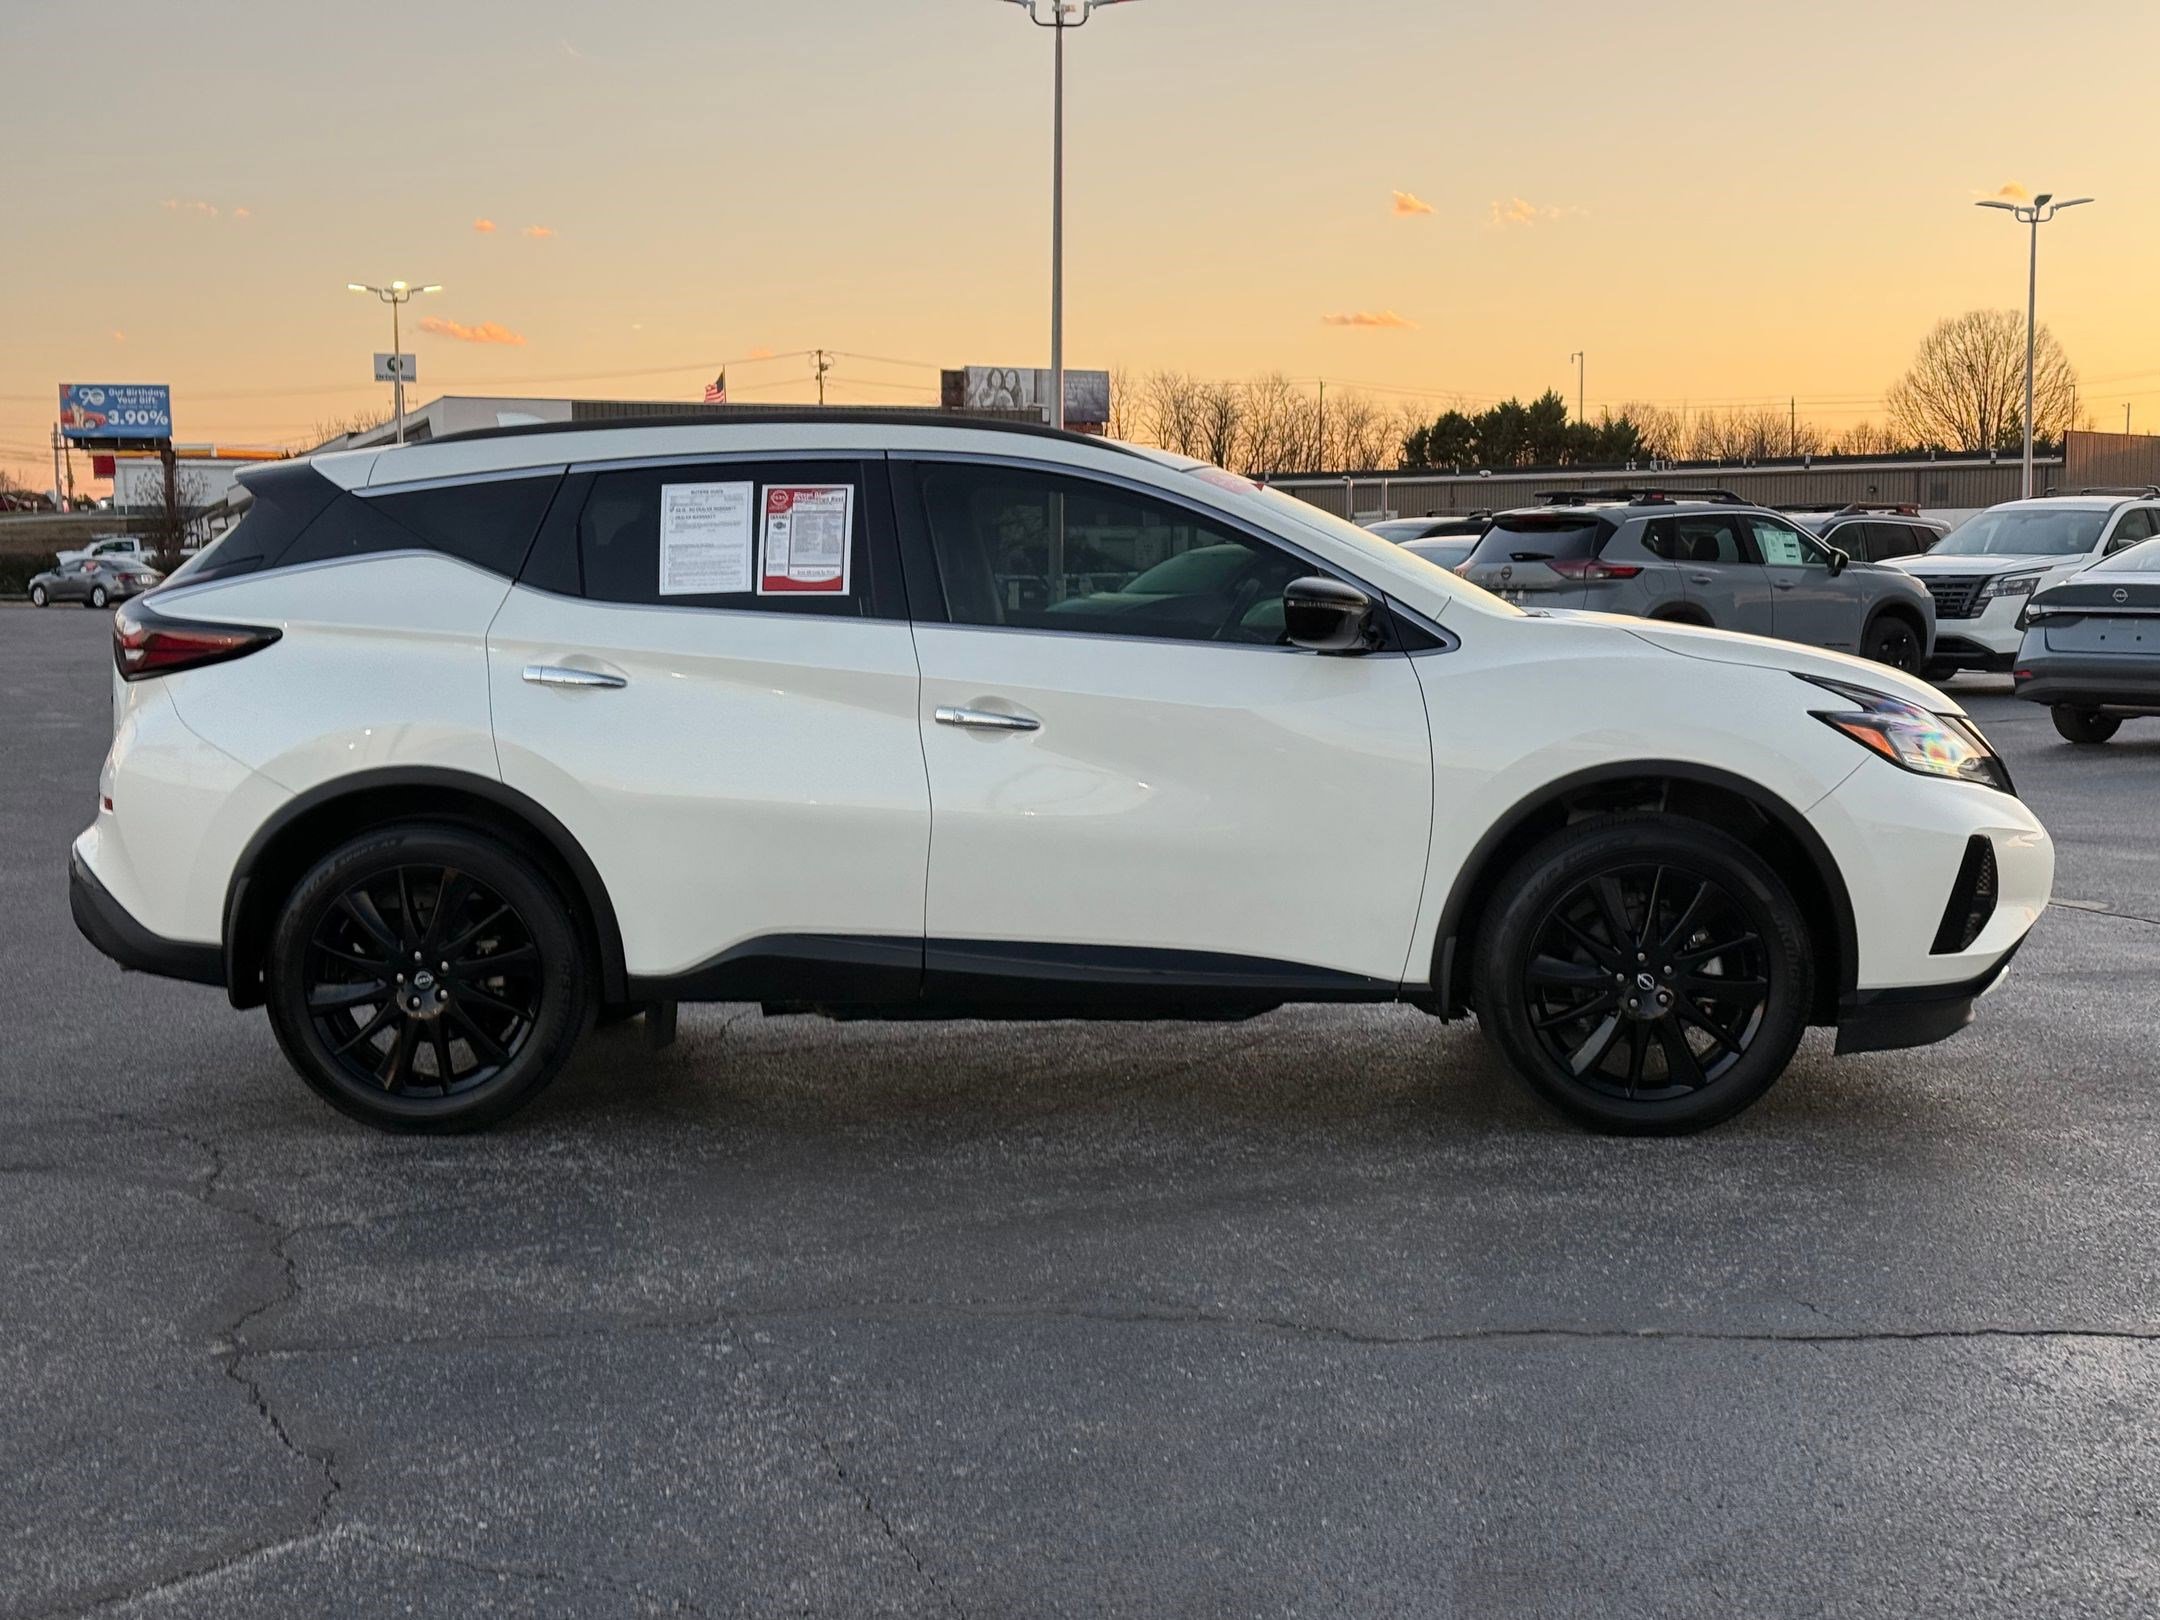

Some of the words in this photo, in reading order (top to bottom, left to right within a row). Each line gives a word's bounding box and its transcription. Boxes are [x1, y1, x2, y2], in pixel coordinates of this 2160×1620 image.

[108, 388, 123, 397] Our
[117, 395, 137, 404] Your
[108, 409, 169, 426] 3.90%
